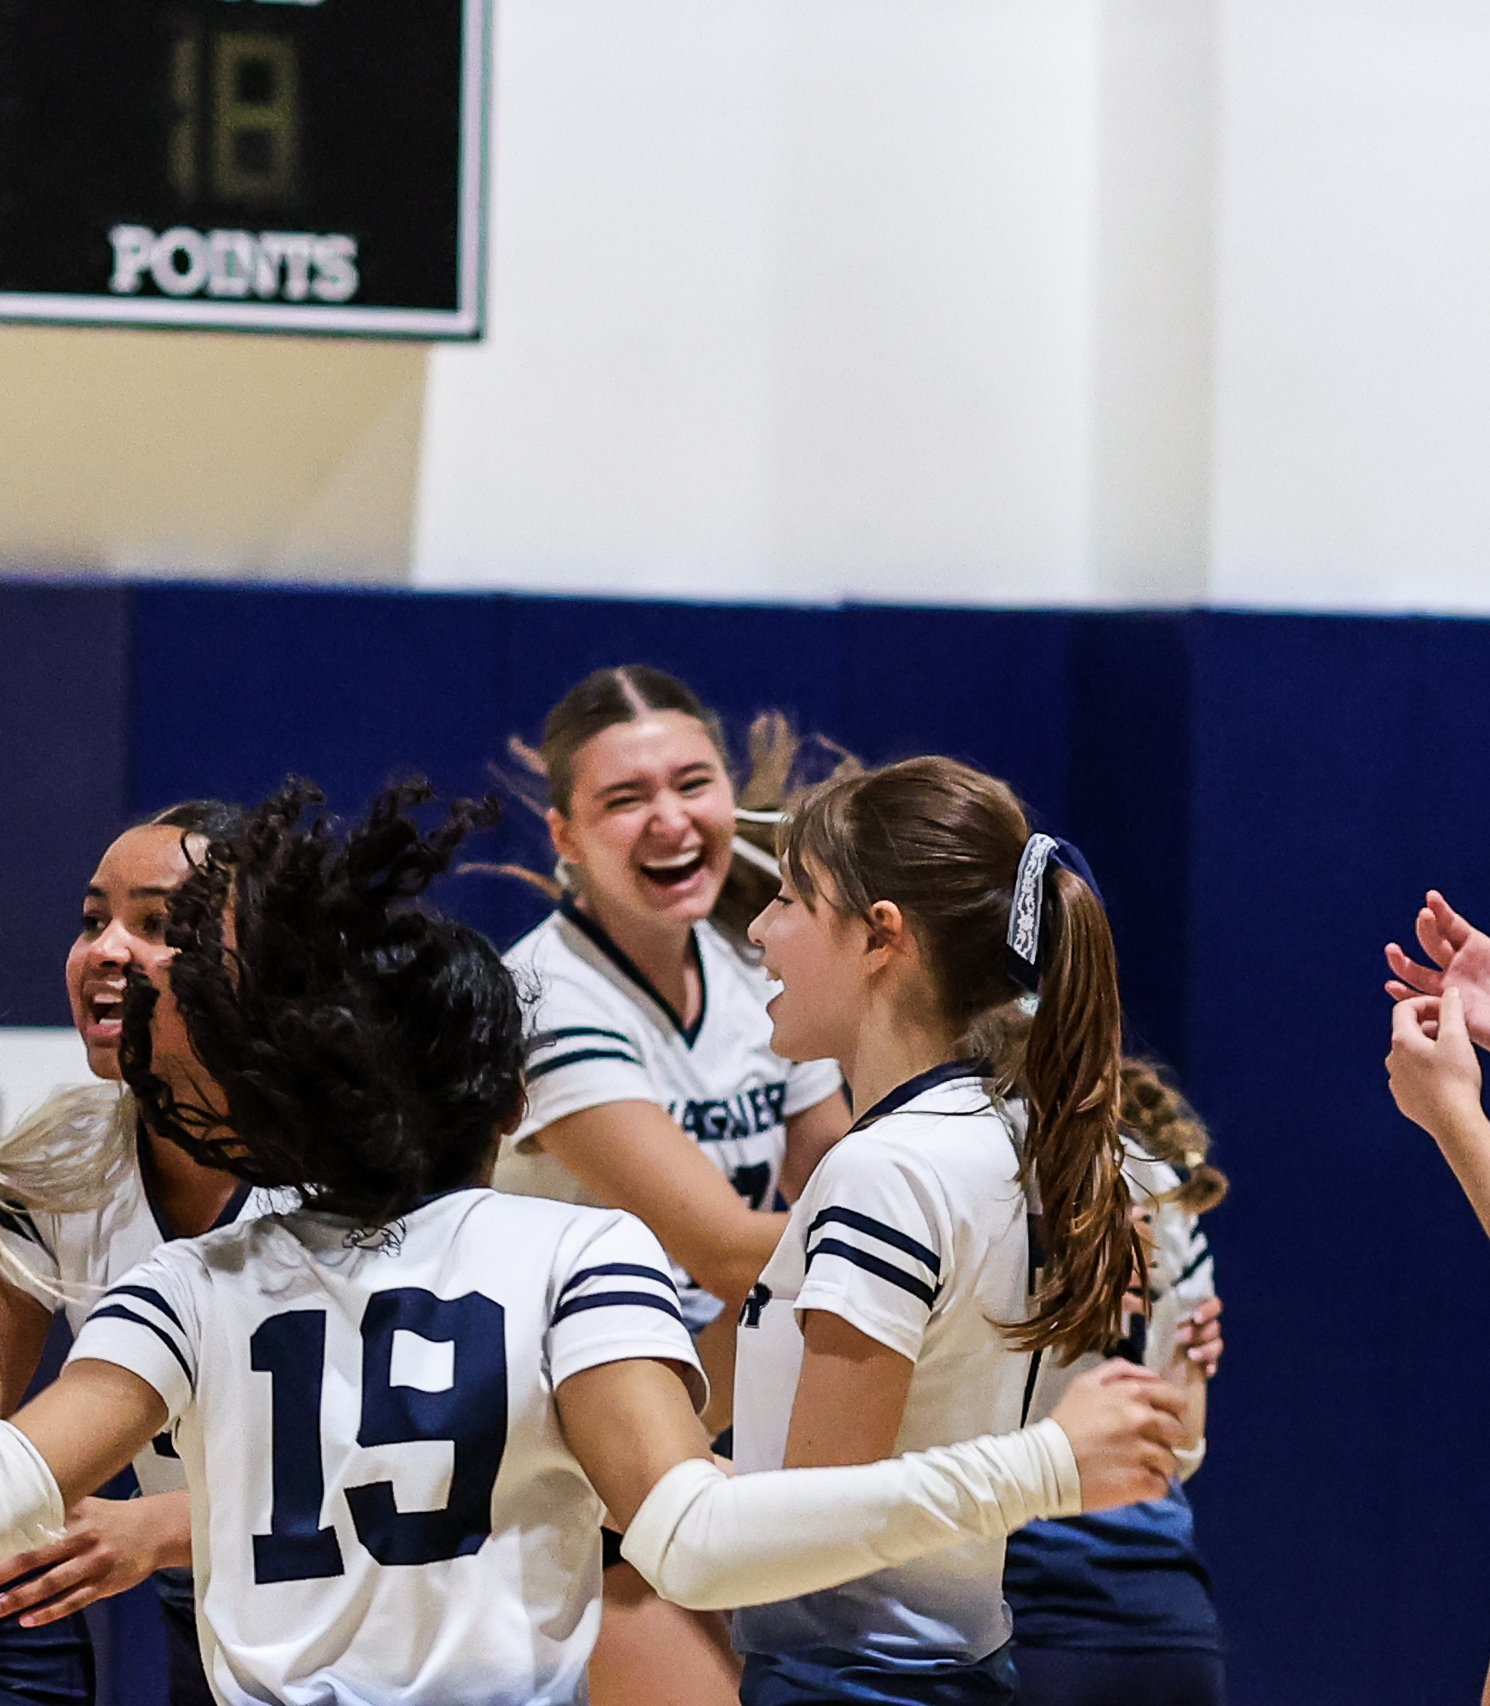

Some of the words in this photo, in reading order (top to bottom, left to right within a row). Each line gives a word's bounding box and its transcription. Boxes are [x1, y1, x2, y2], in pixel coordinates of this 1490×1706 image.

[109, 223, 360, 302] POINTS
[668, 1080, 787, 1141] AGNER
[250, 1286, 509, 1585] 19
